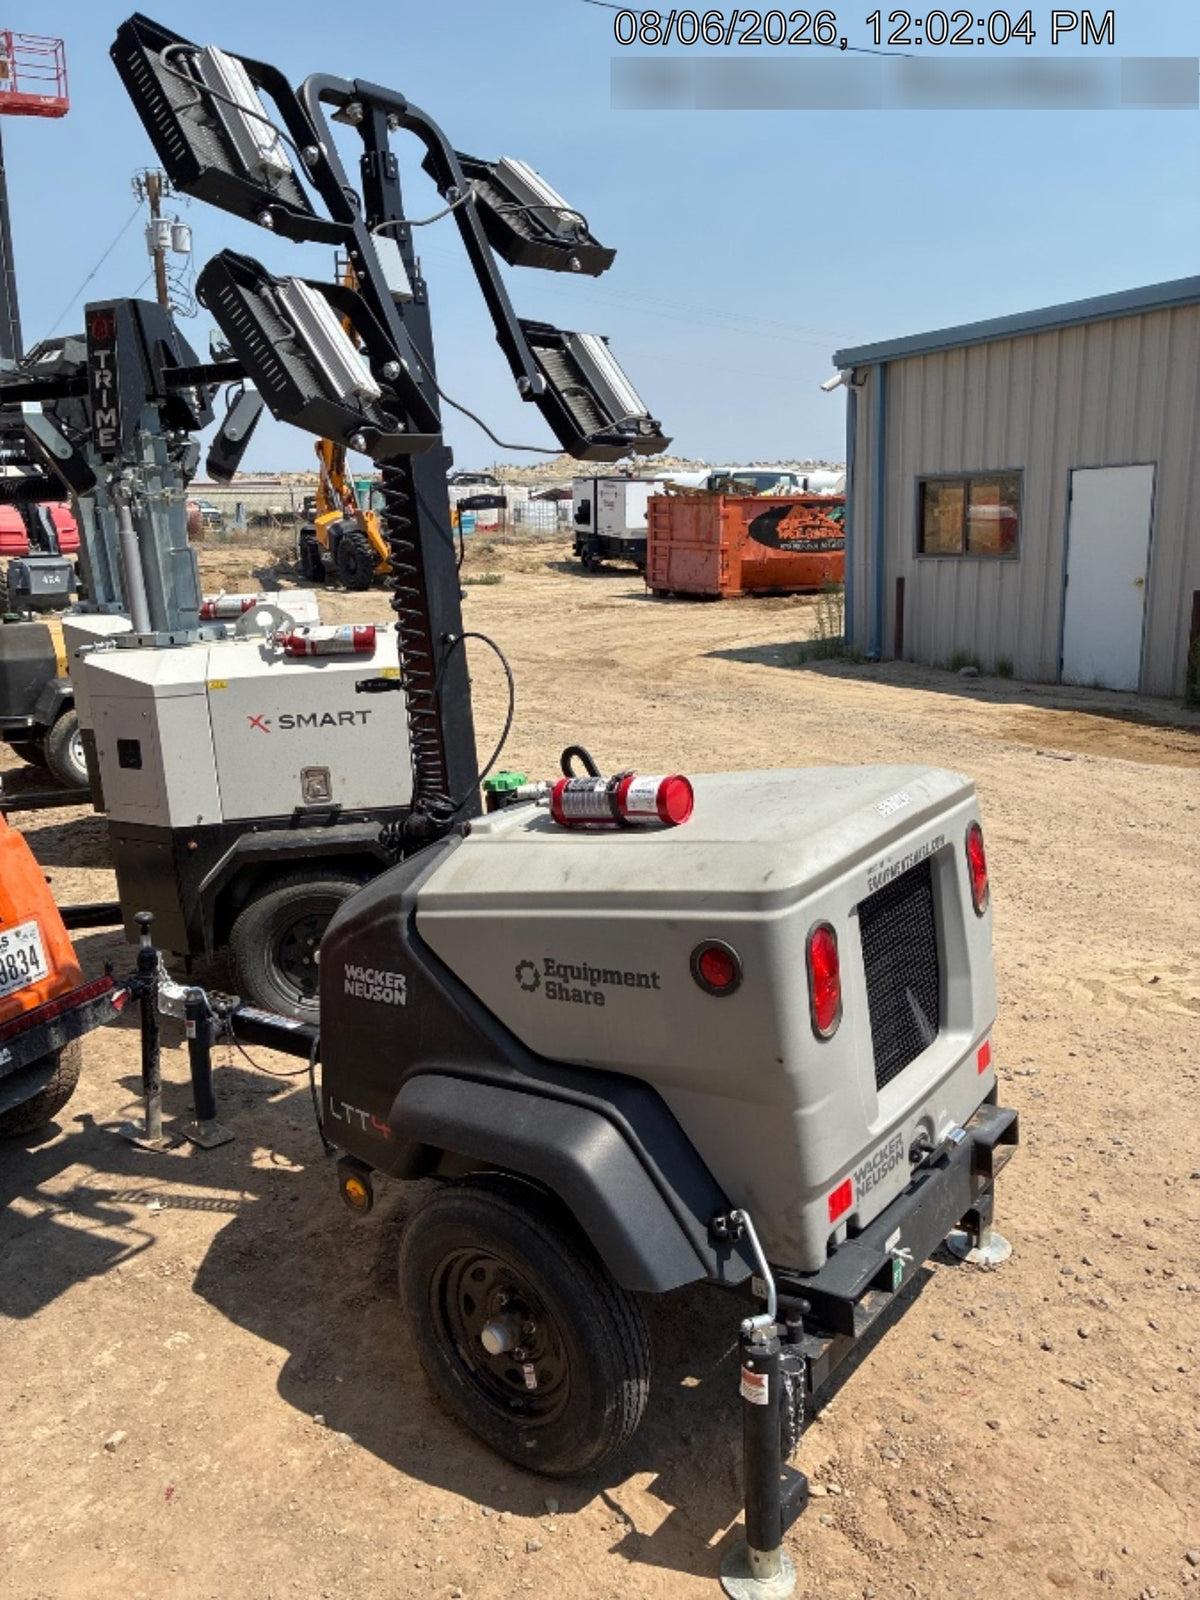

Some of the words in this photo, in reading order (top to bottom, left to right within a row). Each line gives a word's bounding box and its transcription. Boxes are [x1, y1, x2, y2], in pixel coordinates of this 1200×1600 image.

[93, 349, 117, 448] TRIME
[344, 963, 407, 990] WACKER
[543, 958, 661, 990] Equipment
[344, 979, 406, 1007] NEUSON
[545, 981, 605, 1006] Share
[330, 1096, 391, 1138] LTT4
[853, 1132, 903, 1185] WACKER
[856, 1147, 904, 1202] NEUSON
